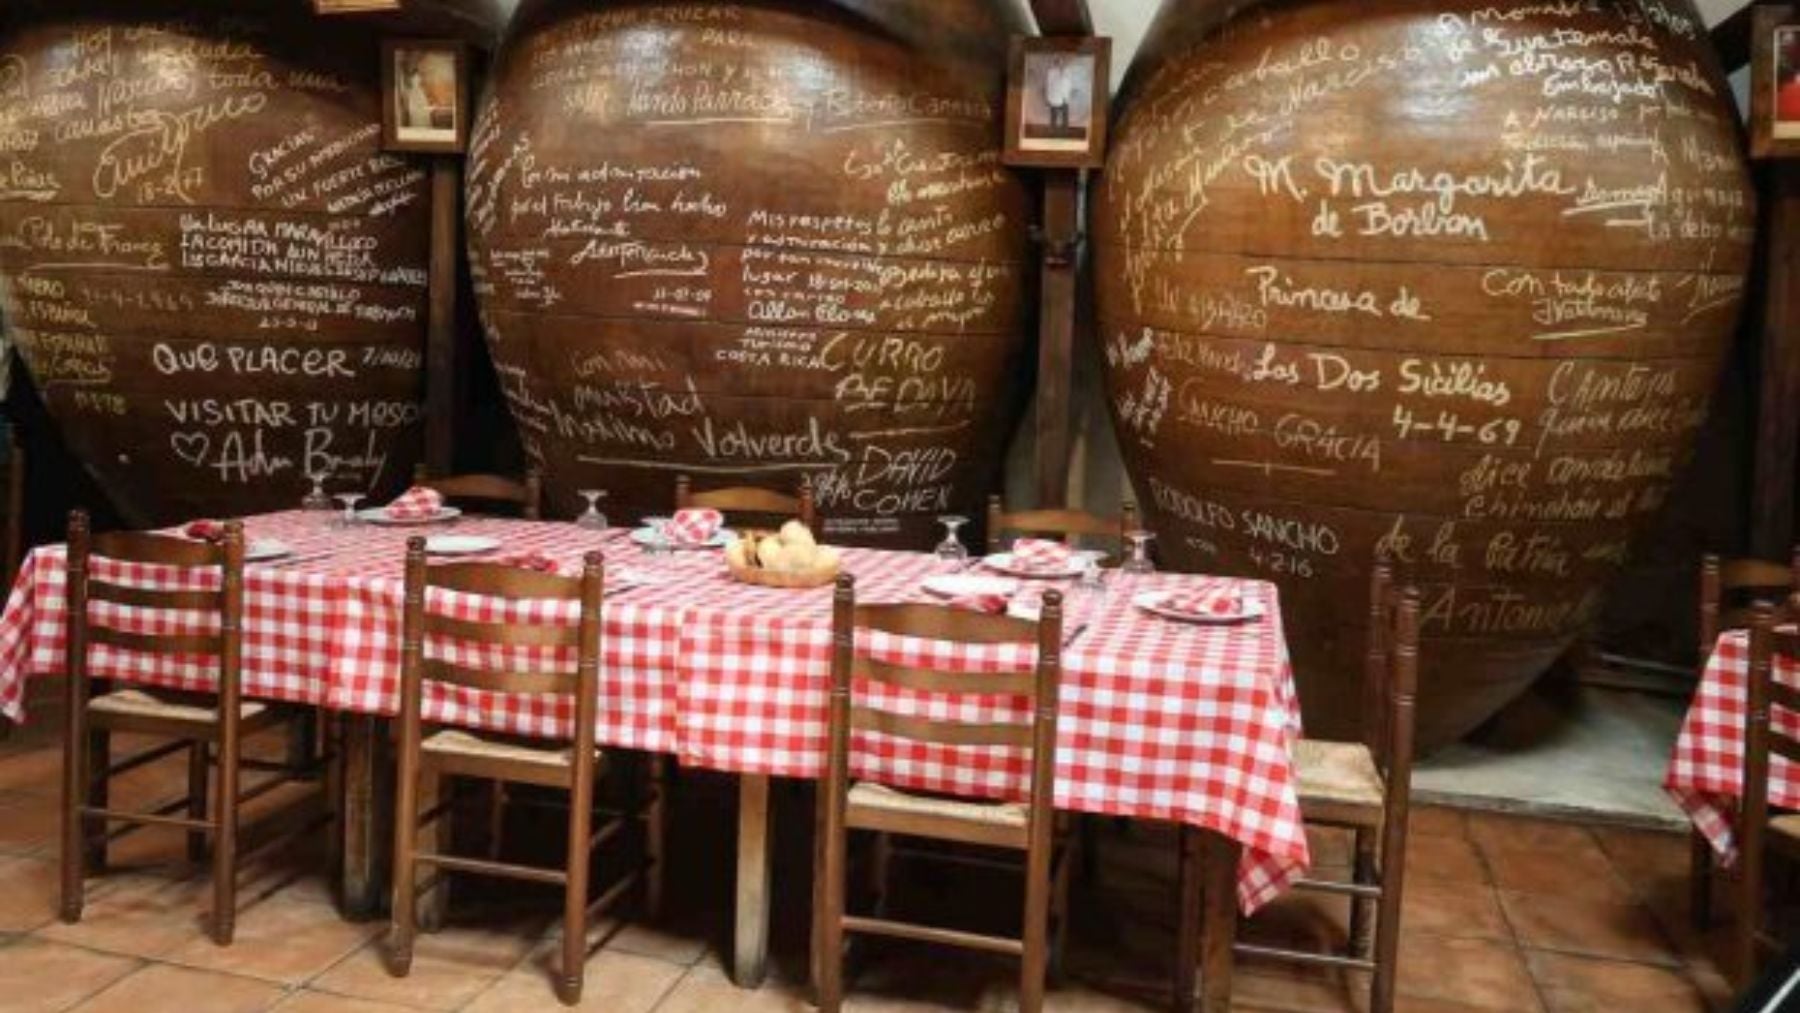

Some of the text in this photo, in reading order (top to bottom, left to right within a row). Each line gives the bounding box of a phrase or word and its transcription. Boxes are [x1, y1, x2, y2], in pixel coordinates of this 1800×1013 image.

[1316, 147, 1577, 215] Margarita
[208, 212, 269, 239] LUGAR
[1310, 198, 1343, 238] de
[1245, 264, 1385, 322] Princesa
[1389, 284, 1433, 321] de
[1481, 268, 1547, 298] Con
[152, 342, 219, 376] QUE
[227, 345, 357, 379] PLACER
[716, 349, 772, 367] COSTA
[819, 331, 946, 373] CURRO
[1306, 350, 1382, 395] Dos
[1397, 357, 1512, 407] Sicilias
[164, 398, 298, 428] VISITAR
[305, 400, 341, 427] TU
[1391, 403, 1523, 446] 4-4-69
[855, 443, 958, 487] DAVID
[1241, 509, 1341, 556] SANCHO
